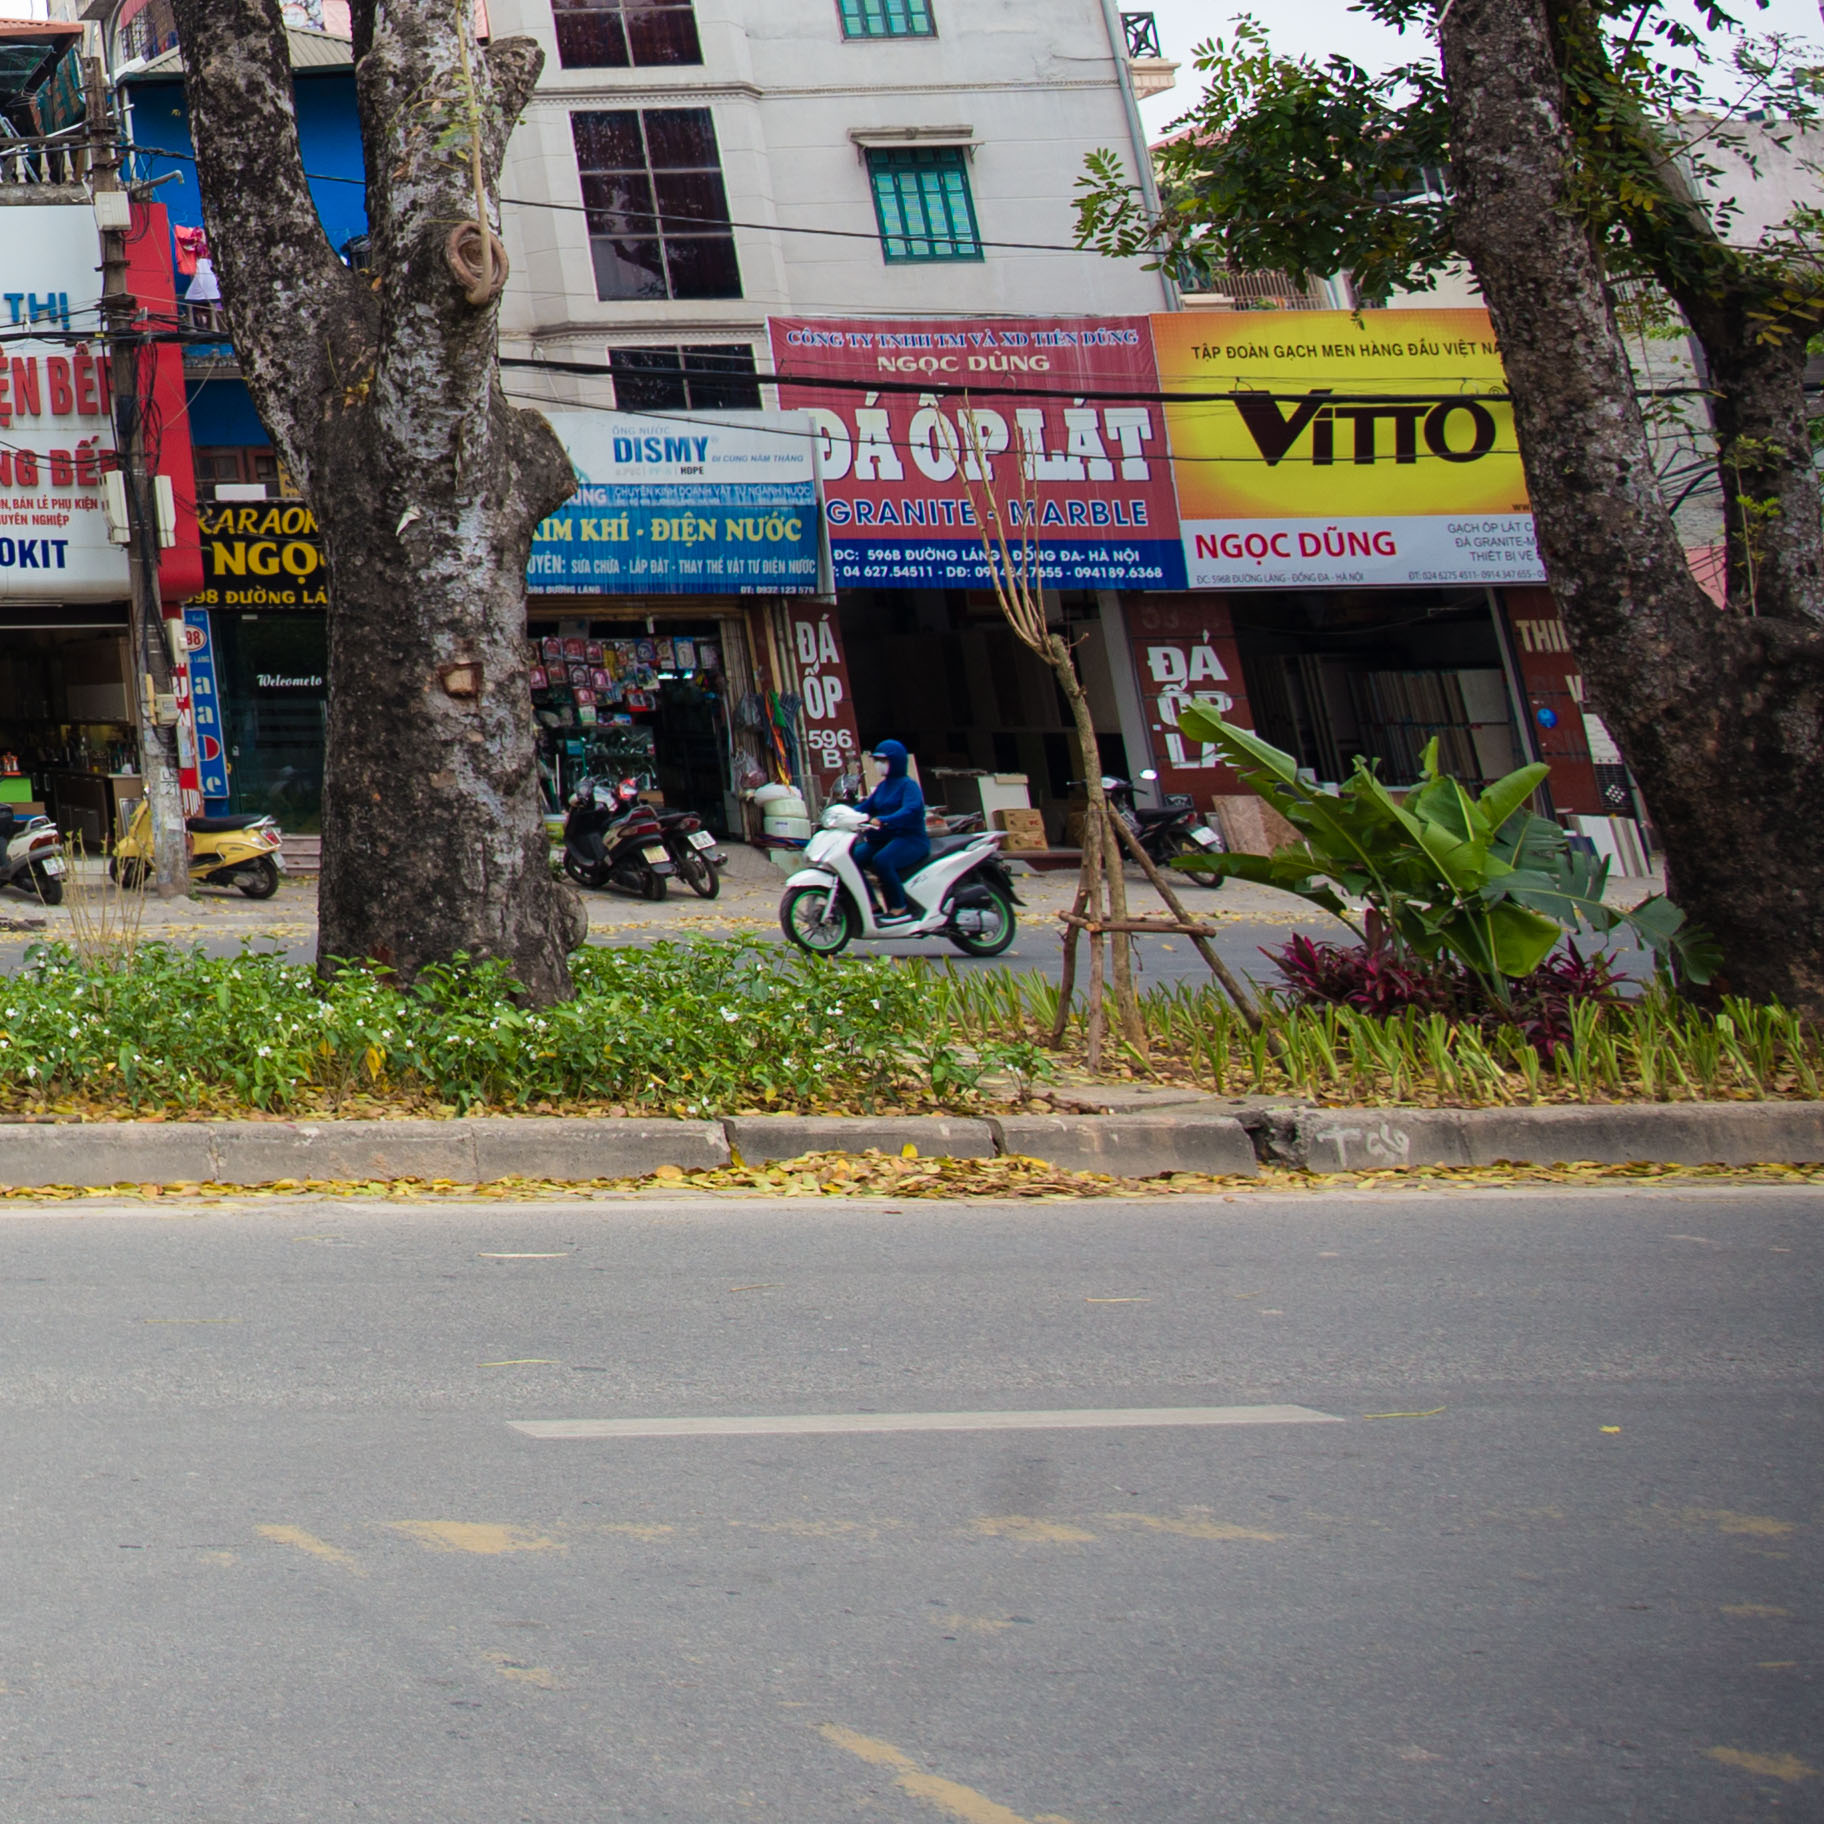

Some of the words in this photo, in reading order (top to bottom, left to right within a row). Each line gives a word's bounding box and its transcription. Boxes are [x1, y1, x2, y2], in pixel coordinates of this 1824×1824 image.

[3, 292, 70, 331] THỊ
[787, 327, 844, 347] CÔNG
[847, 332, 873, 347] TY
[876, 332, 933, 348] TNHH
[934, 332, 967, 348] TM
[971, 328, 1000, 348] VÀ
[1000, 331, 1029, 347] XD
[1191, 342, 1221, 362] TẬP
[1227, 341, 1270, 359] ĐOÀN
[1273, 344, 1318, 362] GẠCH
[1322, 343, 1356, 358] MEN
[1360, 339, 1404, 357] HÀNG
[1407, 336, 1440, 357] ĐẦU
[1442, 338, 1478, 358] VIỆT
[877, 355, 959, 377] NGỌC
[612, 435, 710, 464] DISMY
[796, 391, 904, 482] ĐÁ
[1015, 394, 1153, 482] LÁT
[826, 498, 978, 527] GRANITE
[1007, 499, 1149, 528] MARBLE
[580, 511, 630, 542] KHÍ
[651, 511, 716, 547] ĐIỆN
[725, 510, 803, 542] NƯỚC
[833, 549, 860, 561] ĐC:
[867, 548, 902, 561] 596B
[904, 546, 958, 562] ĐƯỜNG
[962, 546, 1001, 562] LÁNG
[1195, 531, 1292, 565] NGỌC
[1298, 526, 1397, 557] DŨNG
[211, 540, 326, 585] NGỌ
[679, 558, 704, 574] THAY
[726, 555, 744, 577] VẬT
[762, 554, 786, 577] ĐIỆN
[787, 552, 816, 574] NƯỚC
[224, 585, 296, 605] ĐƯỜNG
[795, 613, 841, 664] ĐÁ
[1147, 629, 1230, 682] ĐÁ
[803, 659, 844, 720] ỐP
[808, 729, 853, 750] 596
[822, 749, 843, 769] B
